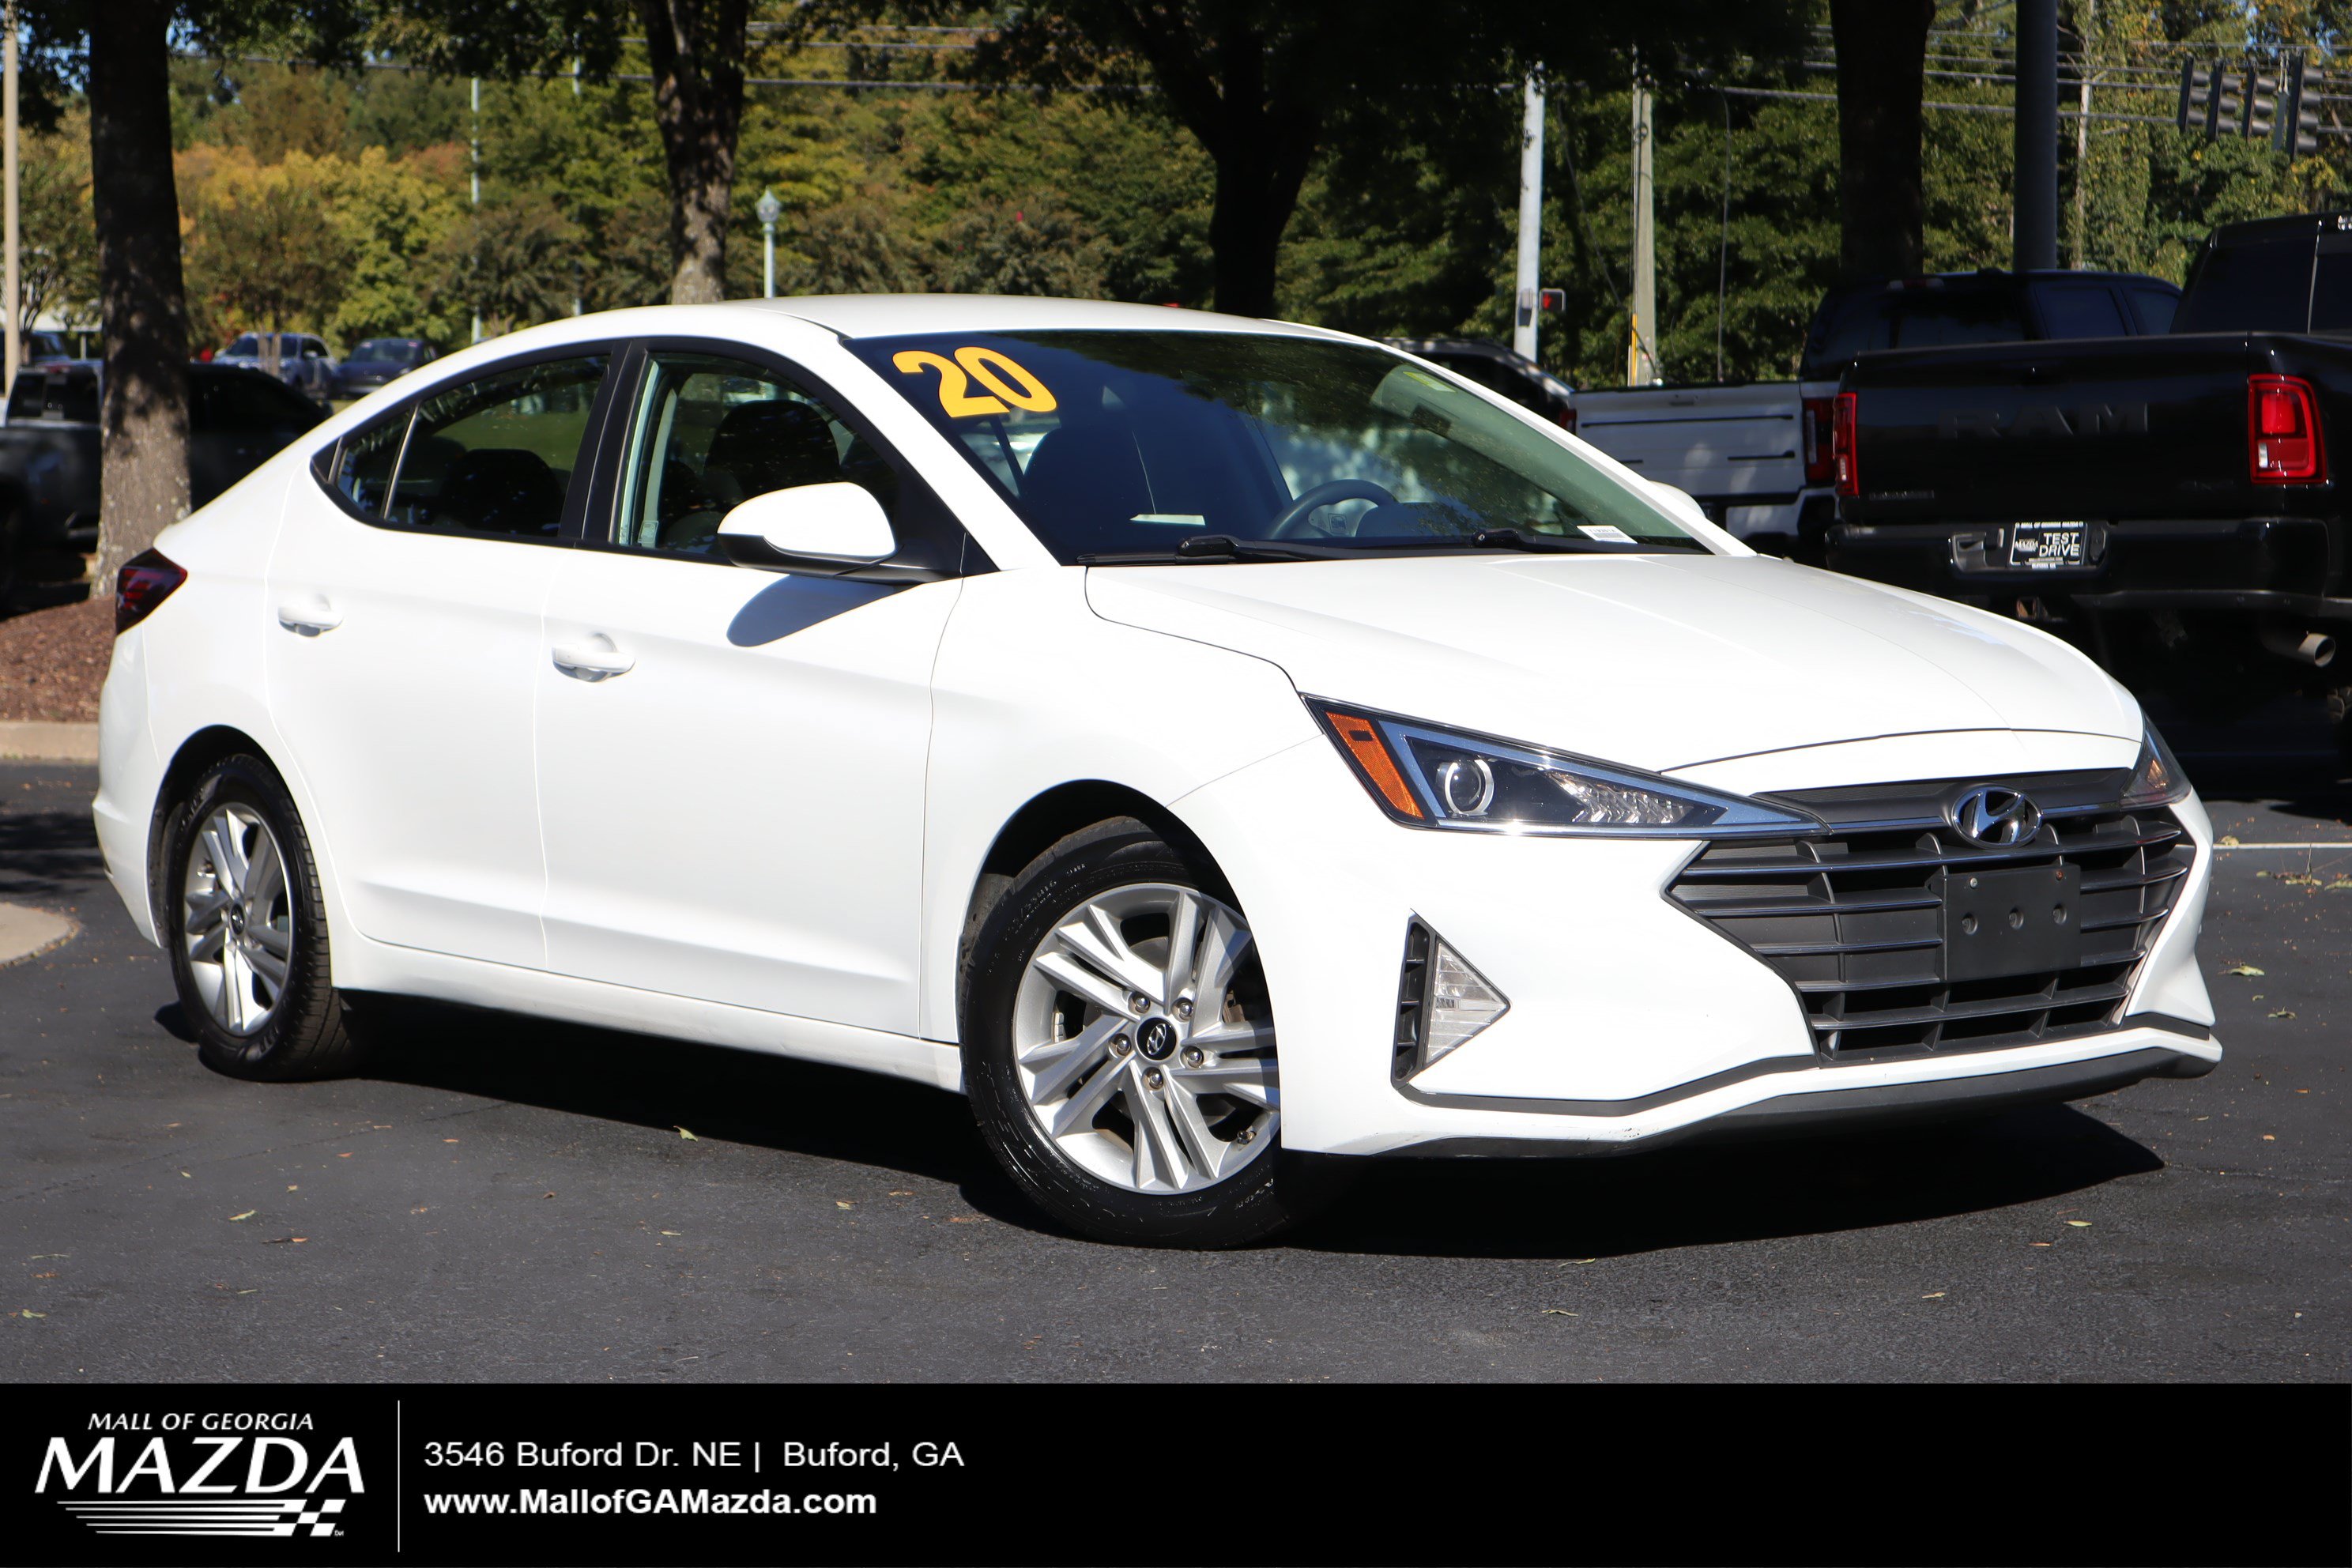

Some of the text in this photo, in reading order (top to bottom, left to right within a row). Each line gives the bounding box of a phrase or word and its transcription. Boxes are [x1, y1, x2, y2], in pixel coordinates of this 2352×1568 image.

[892, 346, 1057, 418] 20
[1939, 401, 2150, 442] RAM
[2039, 543, 2080, 557] DRIVE
[2043, 532, 2079, 545] TEST
